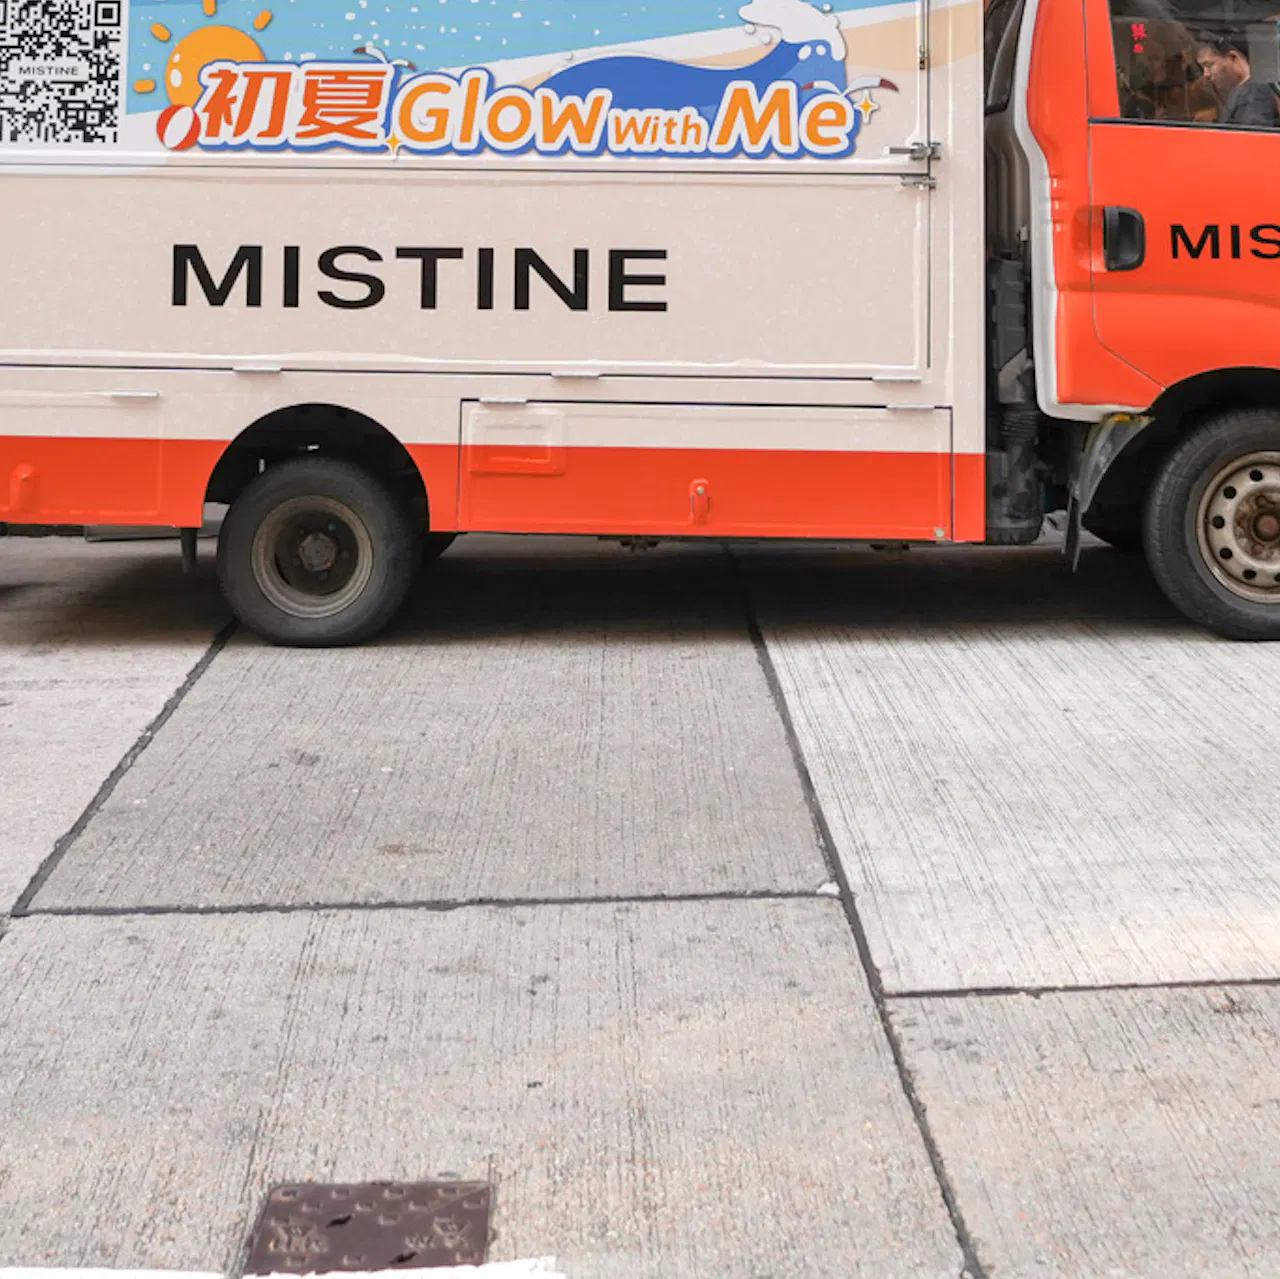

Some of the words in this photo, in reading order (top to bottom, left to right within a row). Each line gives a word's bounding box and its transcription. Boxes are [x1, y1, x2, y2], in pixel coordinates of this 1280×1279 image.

[19, 65, 79, 76] MISTINE
[202, 68, 386, 139] 初夏
[399, 76, 605, 144] Glow
[716, 88, 847, 146] Me
[172, 244, 668, 312] MISTINE
